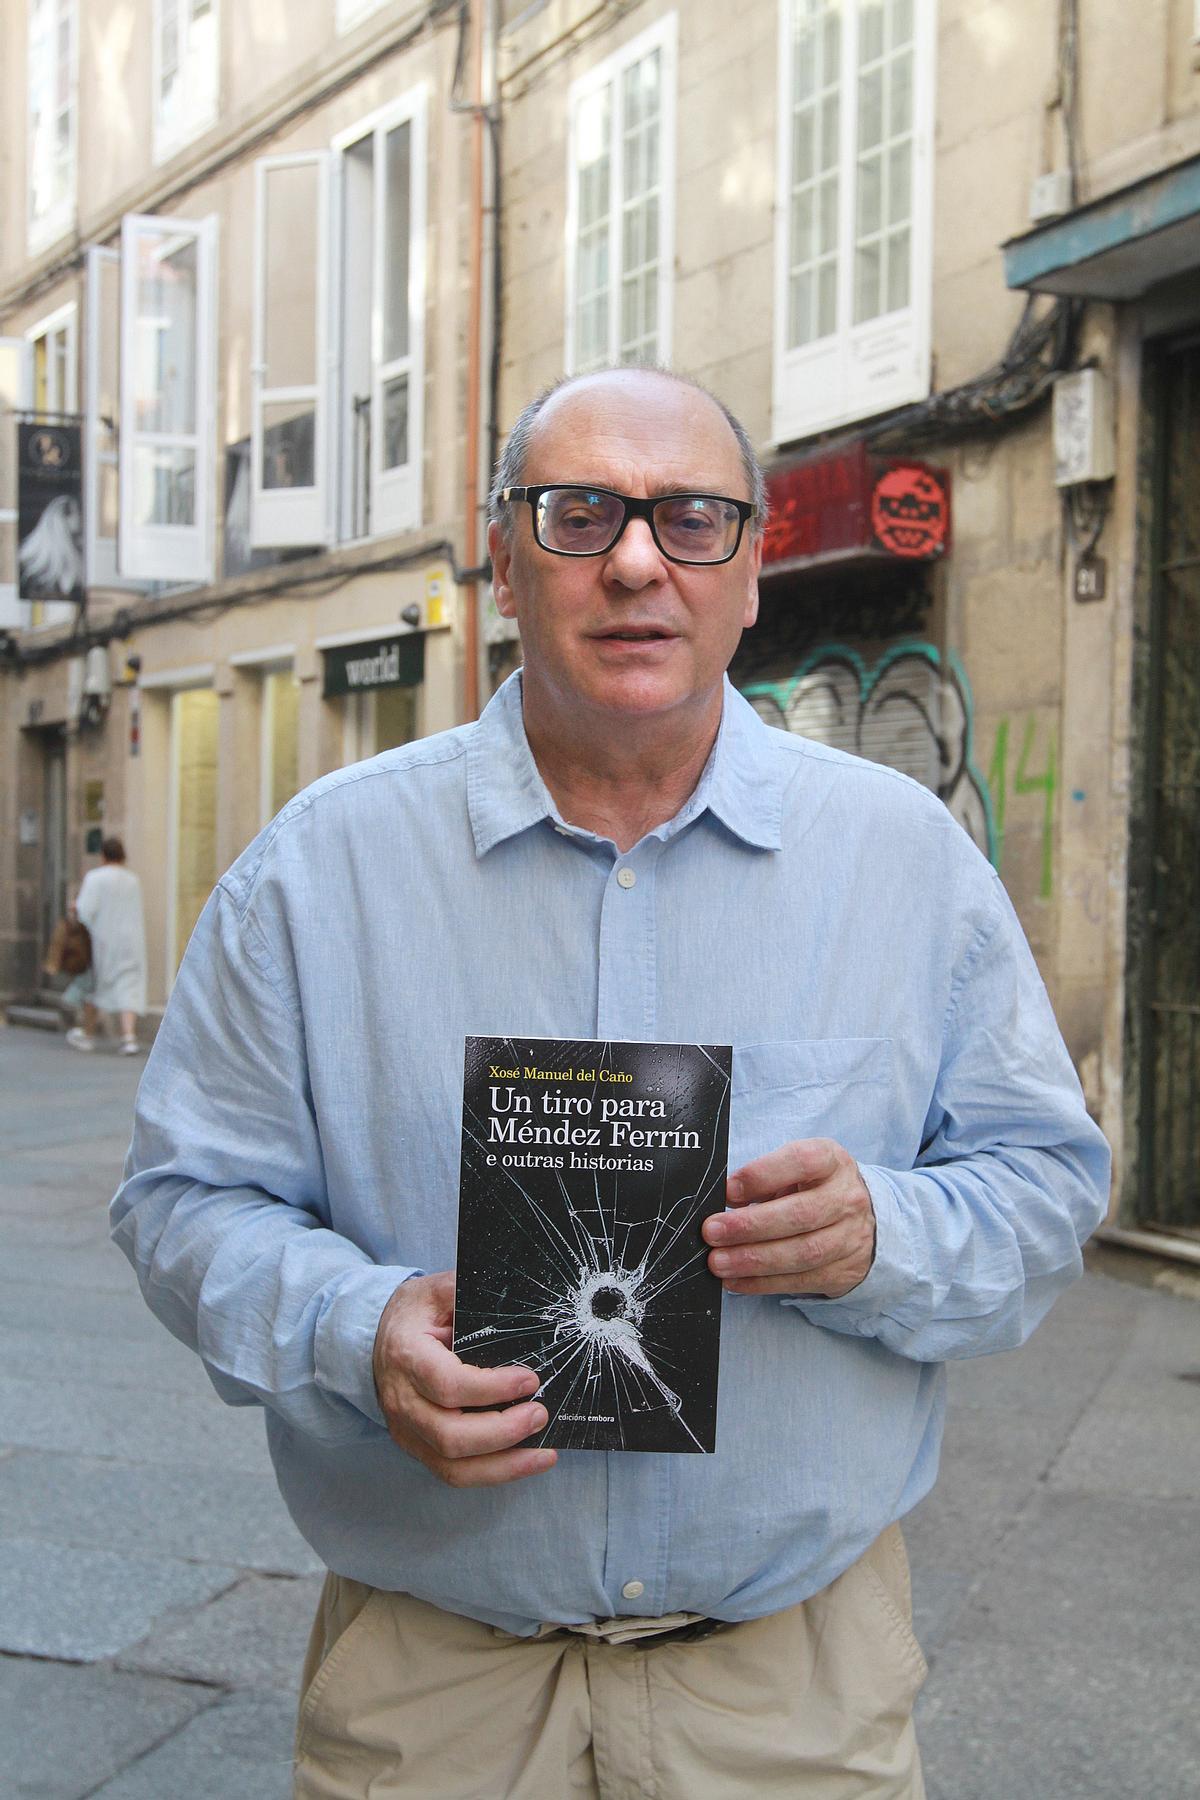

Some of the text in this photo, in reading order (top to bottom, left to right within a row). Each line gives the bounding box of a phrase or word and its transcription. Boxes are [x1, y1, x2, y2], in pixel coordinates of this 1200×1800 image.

[345, 644, 400, 686] world
[489, 1065, 633, 1083] Xosé Manuel del Caño
[489, 1086, 666, 1123] Un tiro para
[487, 1116, 701, 1149] Méndez Ferrín
[486, 1152, 654, 1171] e outras historias
[558, 1413, 615, 1422] edicións embora
